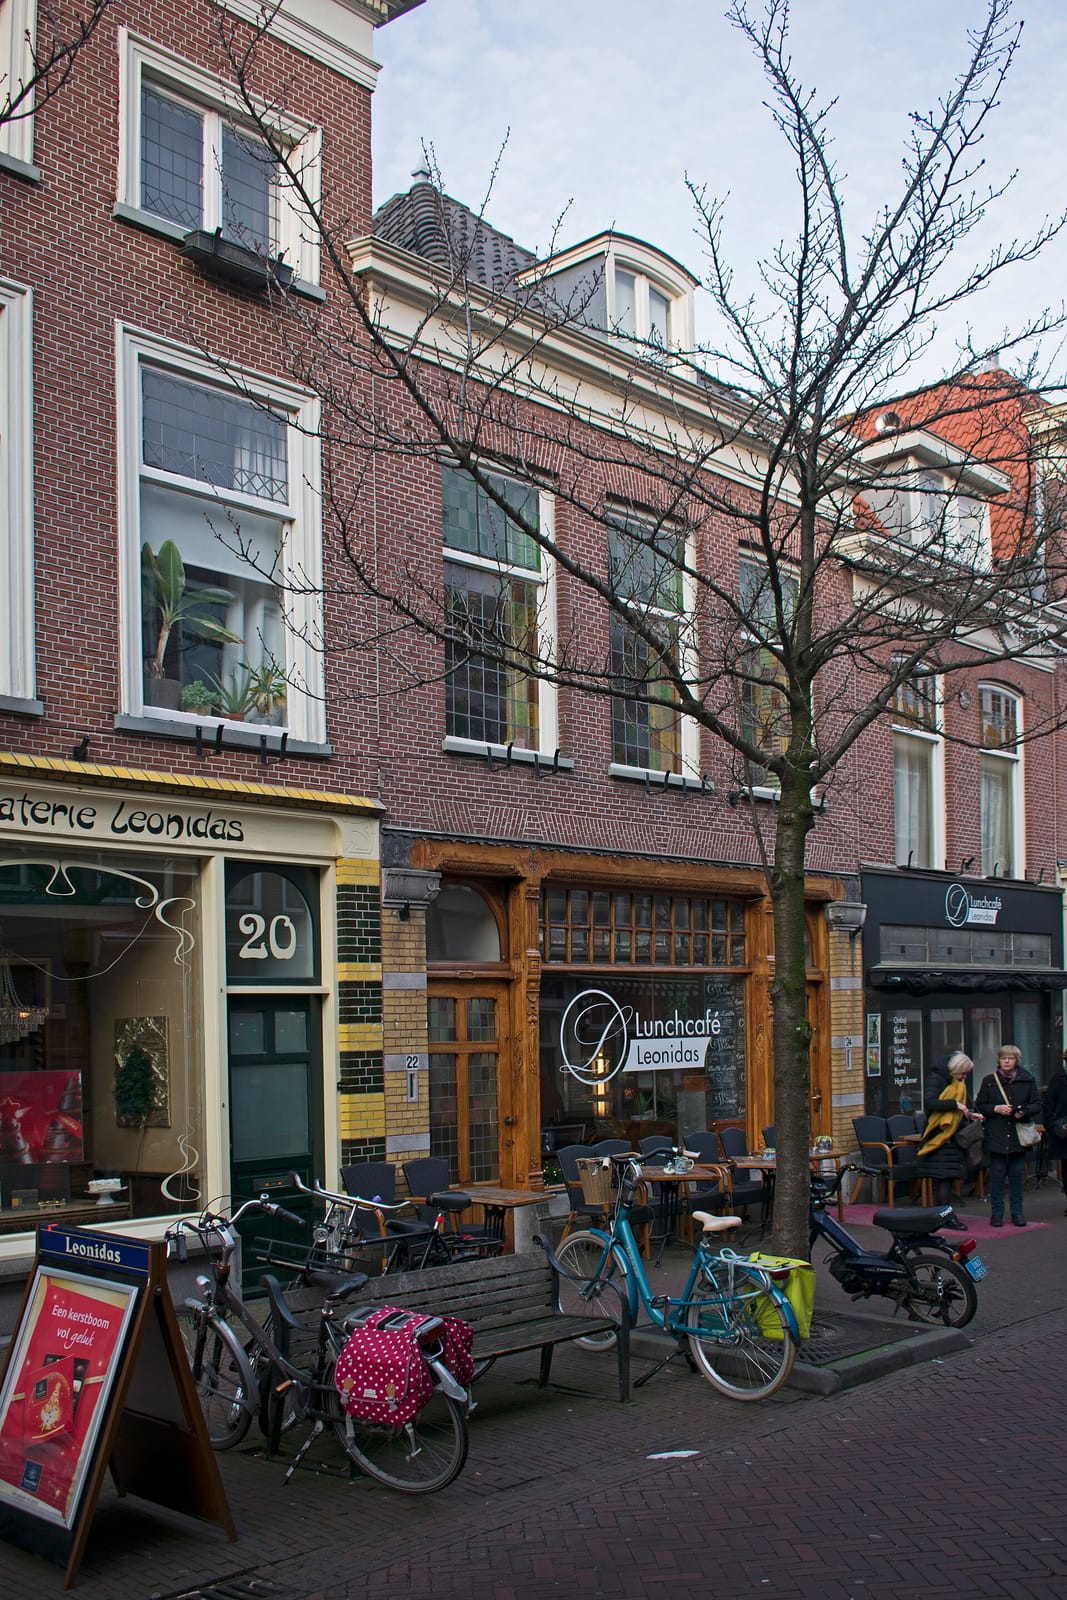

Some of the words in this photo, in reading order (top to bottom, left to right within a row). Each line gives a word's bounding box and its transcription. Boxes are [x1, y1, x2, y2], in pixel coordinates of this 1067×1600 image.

[0, 793, 96, 829] aterie
[111, 801, 244, 841] Leonidas
[970, 895, 1002, 909] Lunchcafé
[238, 913, 297, 960] 20
[635, 1008, 721, 1037] Lunchcafé
[406, 1055, 418, 1069] 22
[637, 1040, 700, 1065] Leonidas
[65, 1236, 121, 1263] Leonidas
[52, 1304, 67, 1318] Een
[67, 1308, 110, 1330] kerstboom
[57, 1327, 70, 1339] vol
[63, 1328, 95, 1350] geluk
